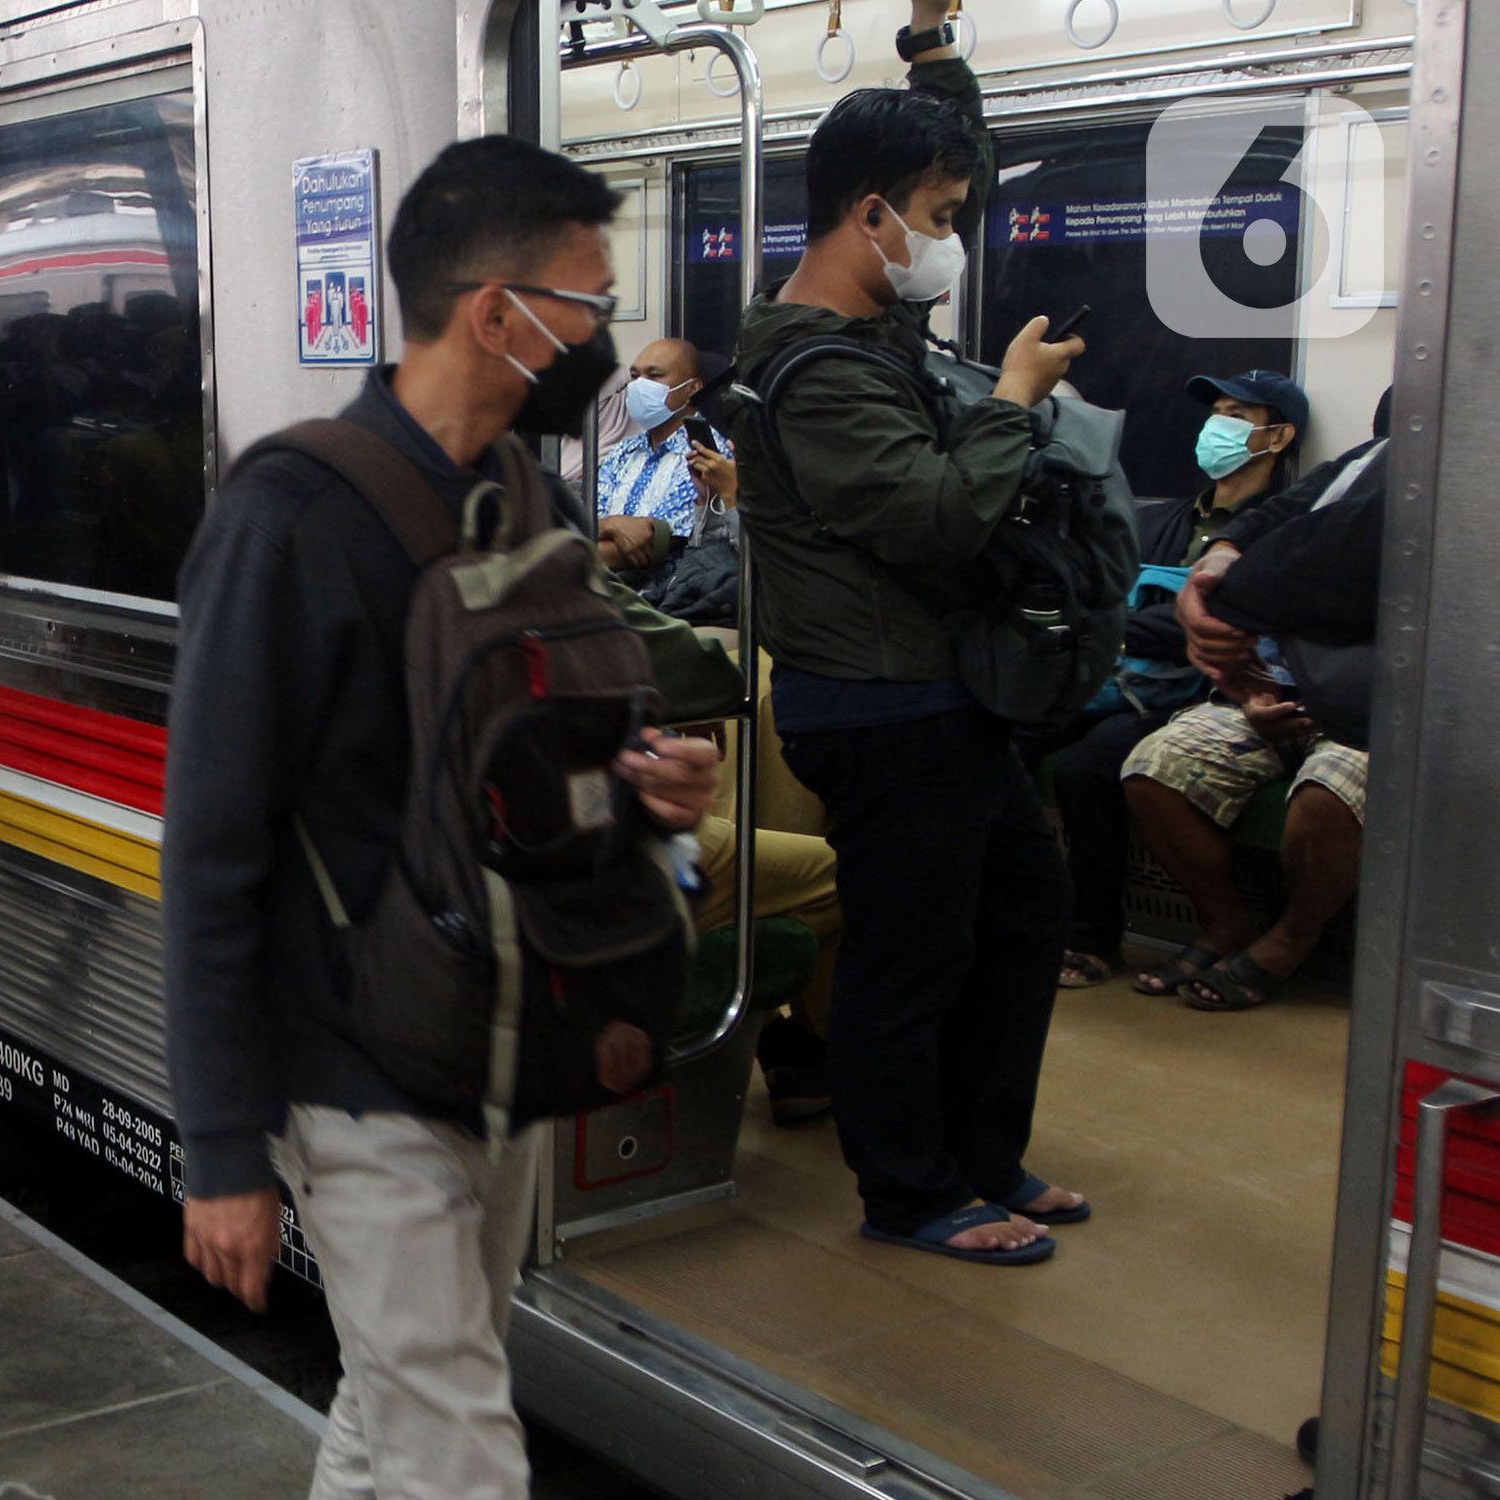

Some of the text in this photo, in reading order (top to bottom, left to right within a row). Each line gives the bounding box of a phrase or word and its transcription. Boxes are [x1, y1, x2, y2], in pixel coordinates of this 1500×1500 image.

[301, 172, 365, 194] Dahulukan
[302, 195, 365, 214] Penumpang
[1066, 203, 1092, 214] Mohon
[1092, 200, 1146, 213] Kesadarannya
[1222, 194, 1254, 206] Tempat
[1255, 192, 1283, 203] Duduk
[306, 216, 362, 236] Yang Turun
[1065, 208, 1246, 227] Kepada Penumpang Yang Lebih Membutuhkan
[52, 1069, 162, 1148] MD 28-09-2005
[77, 1128, 100, 1156] YAD
